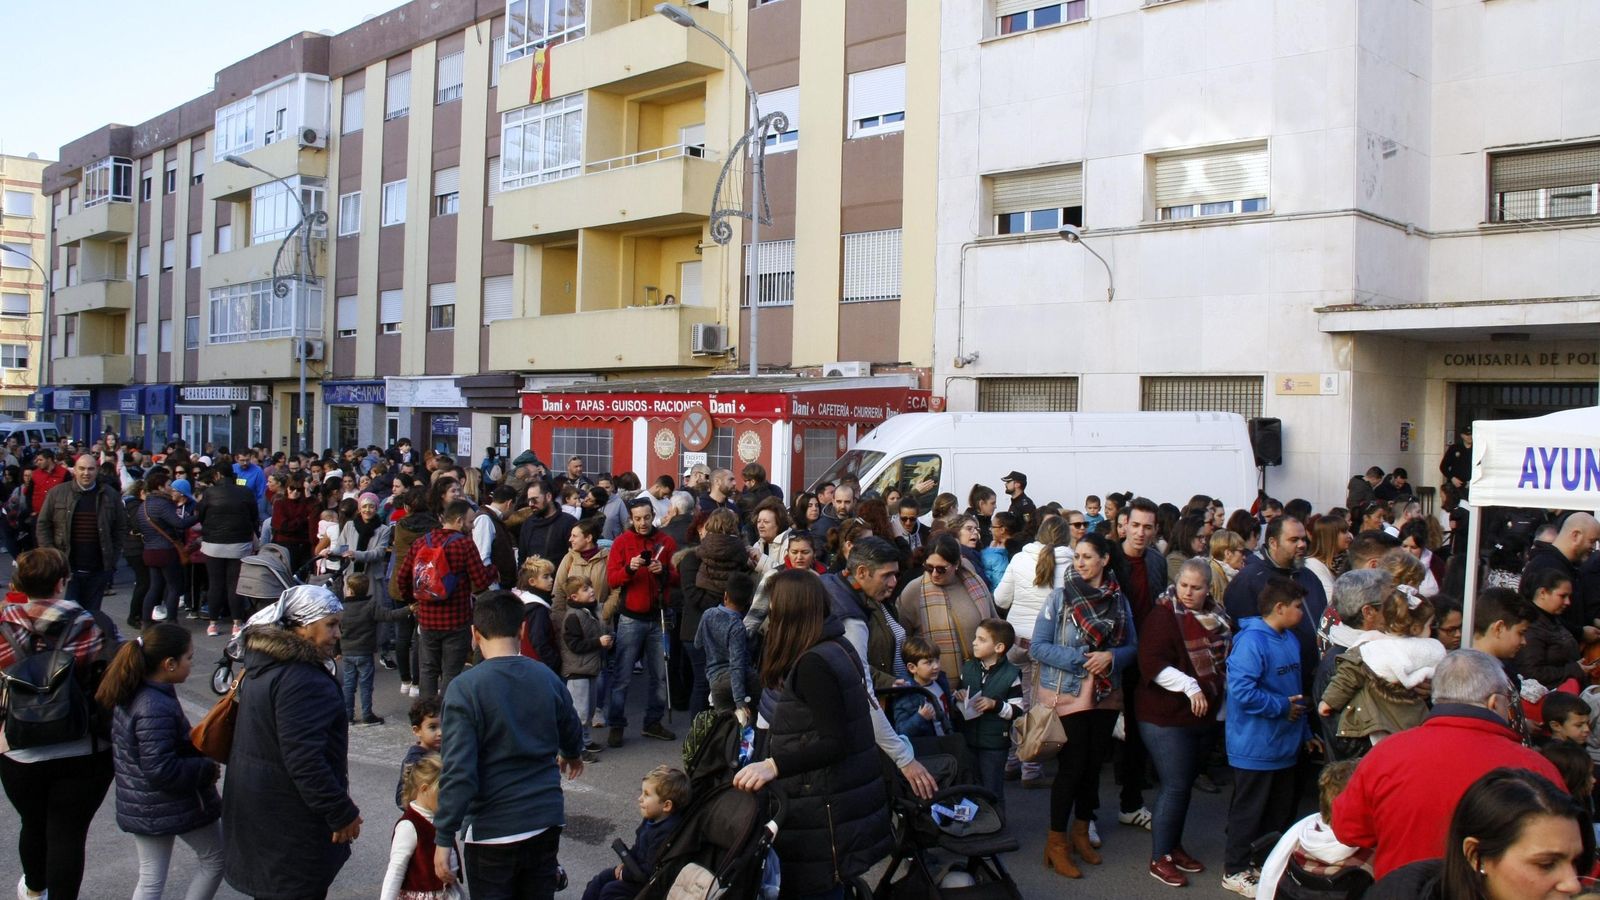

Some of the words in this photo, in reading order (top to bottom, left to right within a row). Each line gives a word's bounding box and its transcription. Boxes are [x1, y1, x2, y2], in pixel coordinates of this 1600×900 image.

[1444, 354, 1531, 366] COMISARIA
[1540, 353, 1559, 365] DE
[542, 399, 563, 412] Dani
[575, 400, 605, 411] TAPAS
[611, 400, 648, 412] GUISOS
[709, 399, 736, 414] Dani
[792, 400, 810, 416] Dani
[1518, 446, 1600, 492] AYUN
